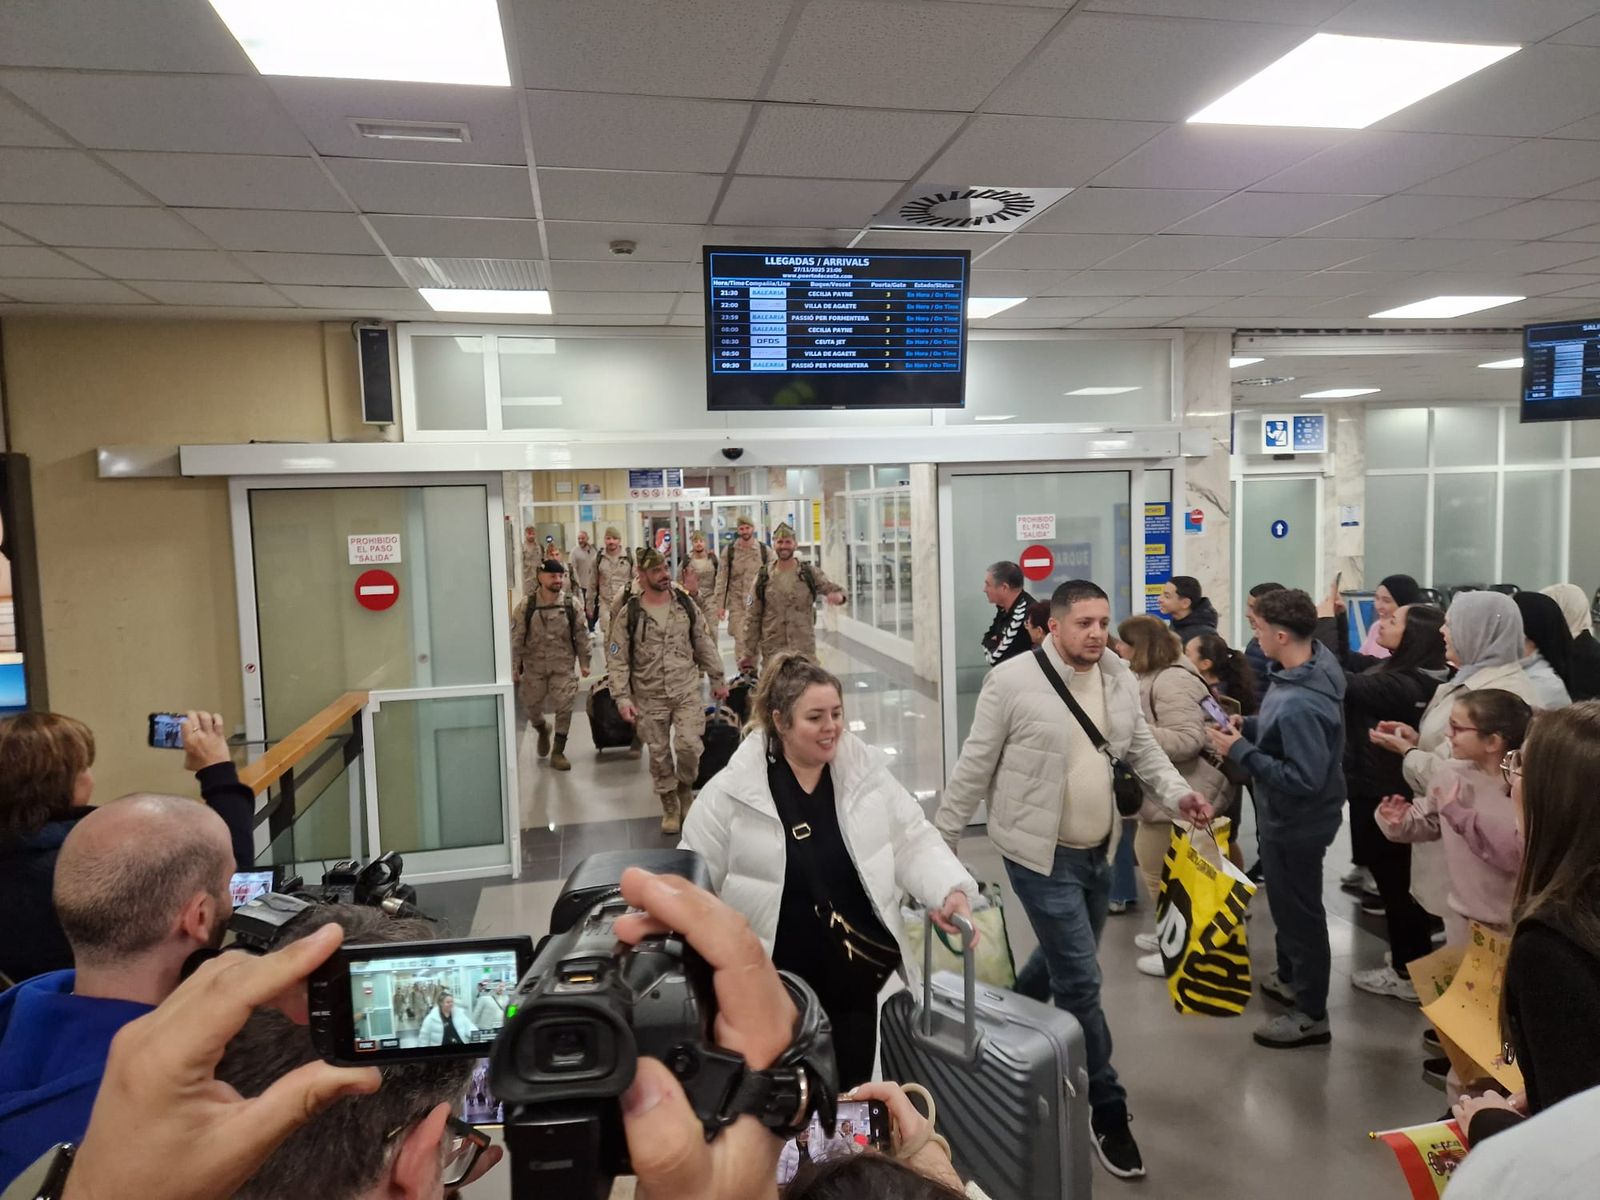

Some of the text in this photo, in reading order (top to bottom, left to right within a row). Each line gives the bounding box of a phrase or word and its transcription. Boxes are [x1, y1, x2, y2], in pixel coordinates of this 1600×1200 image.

[765, 257, 814, 265] LLEGADAS
[824, 258, 870, 266] ARRIVALS
[351, 536, 398, 544] PROHIBIDO
[356, 554, 393, 562] "SALIDA"
[1056, 551, 1088, 565] ARQUE
